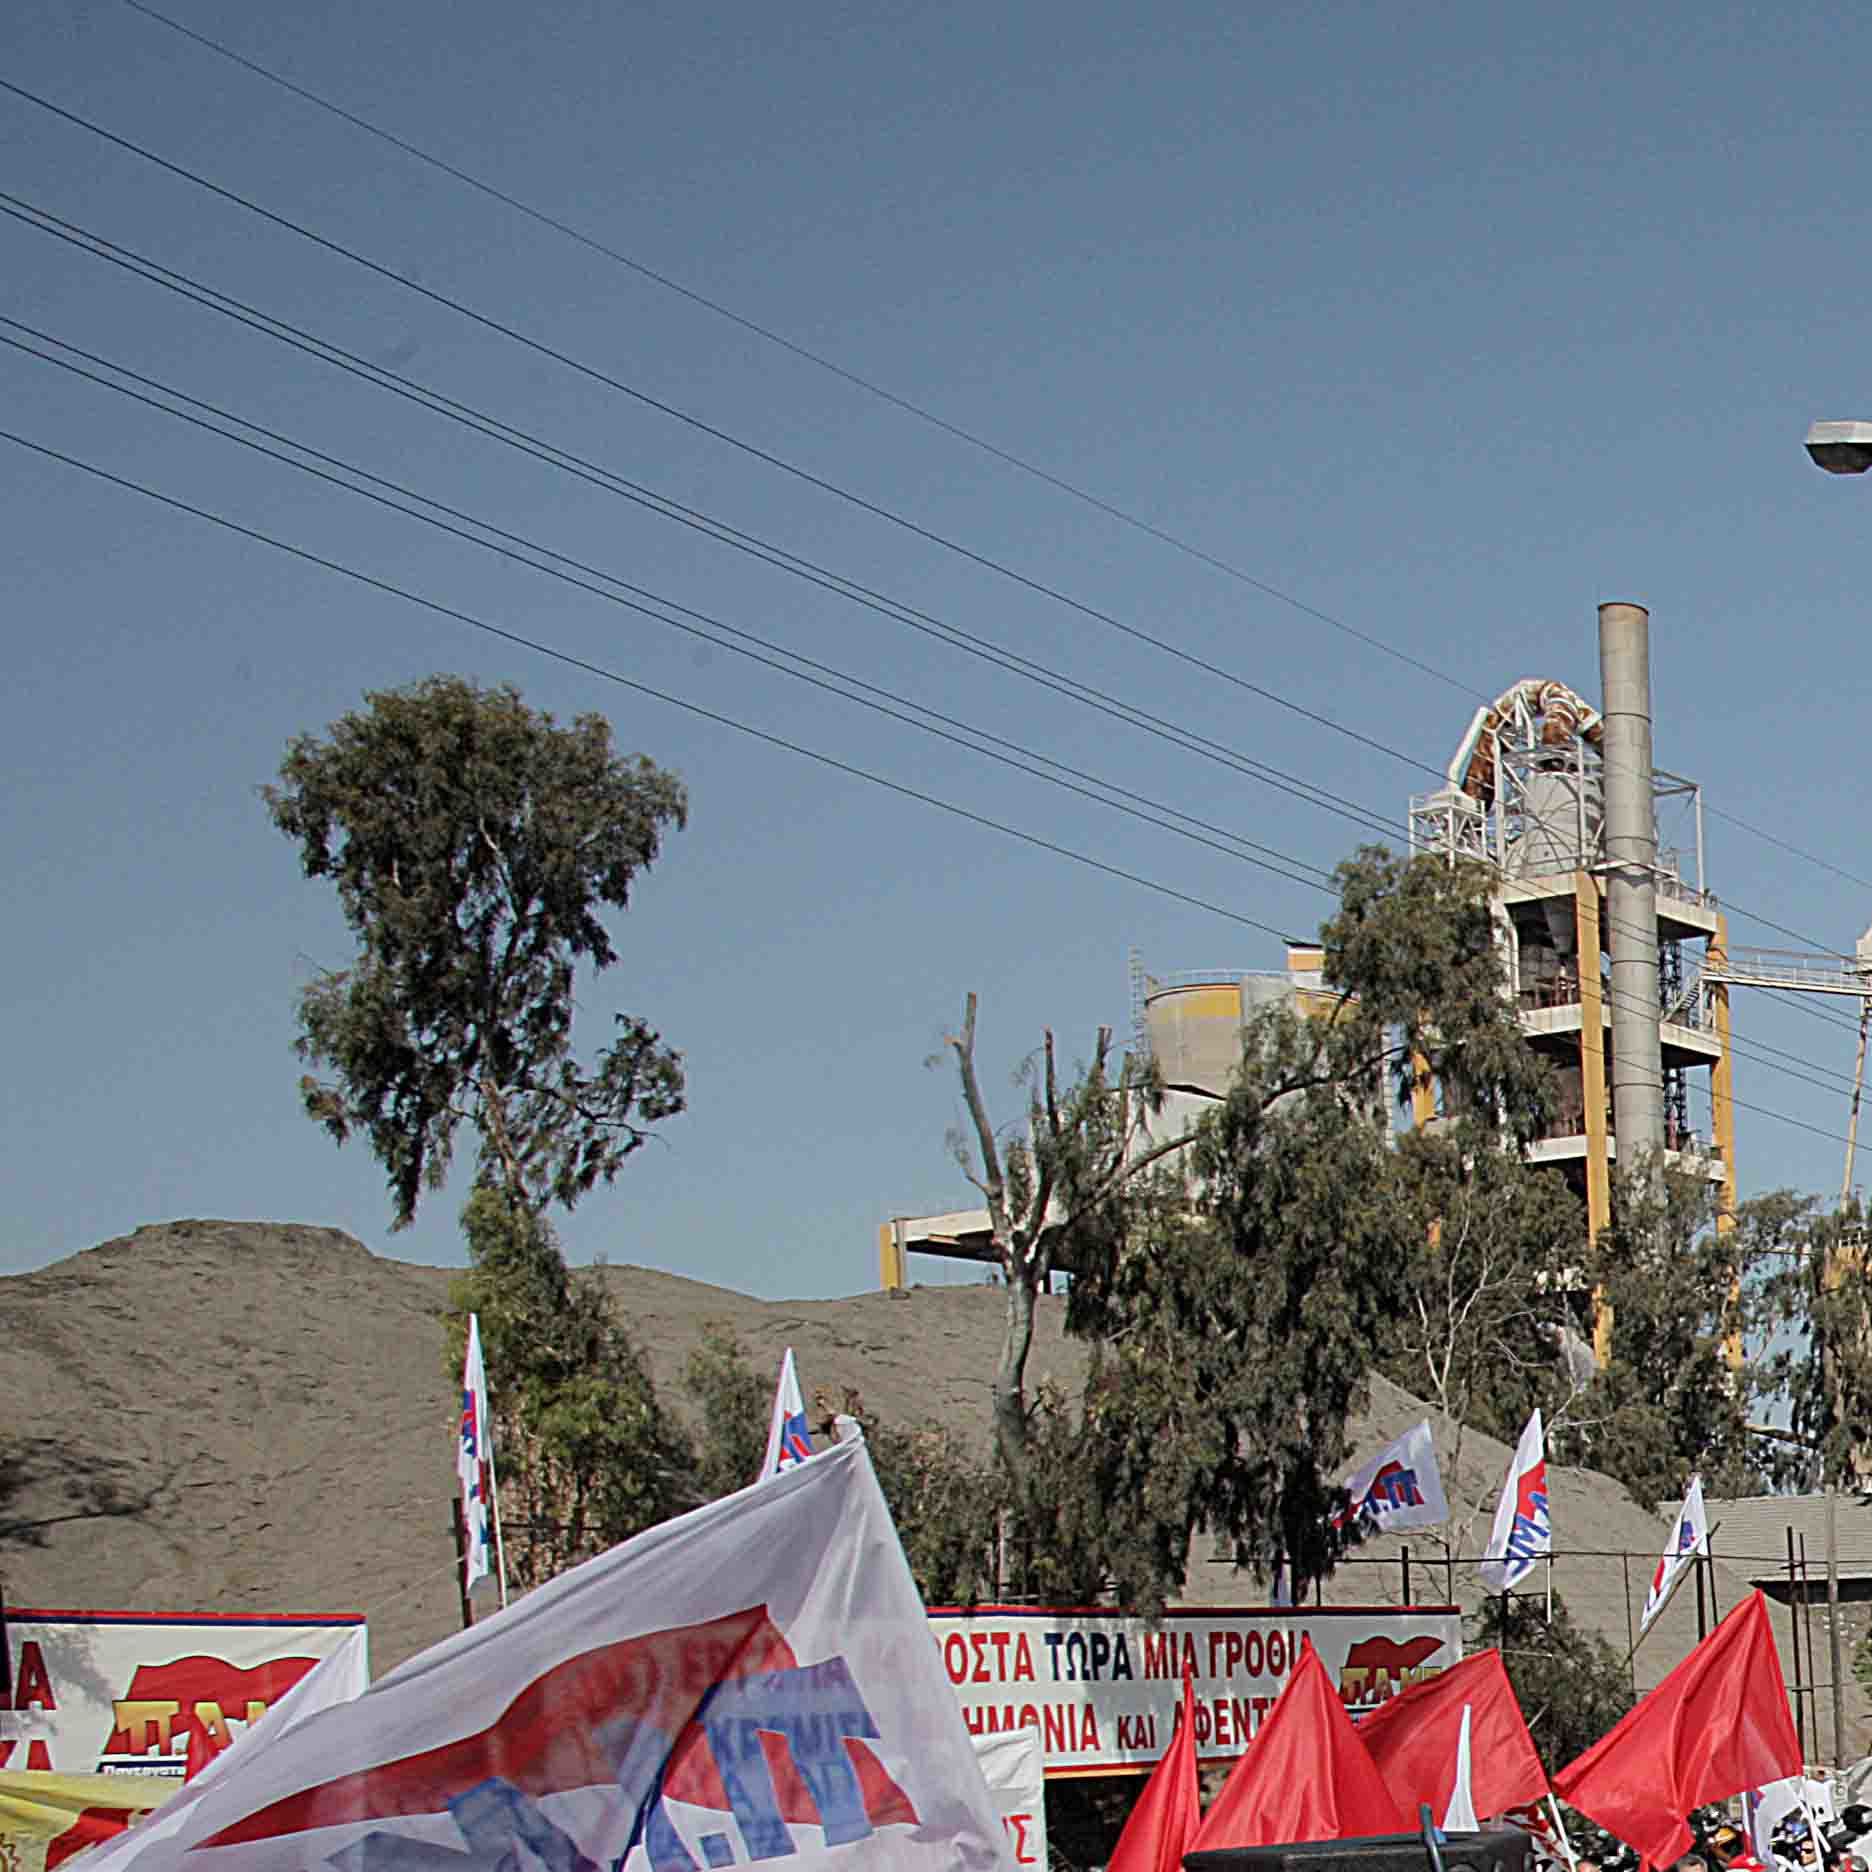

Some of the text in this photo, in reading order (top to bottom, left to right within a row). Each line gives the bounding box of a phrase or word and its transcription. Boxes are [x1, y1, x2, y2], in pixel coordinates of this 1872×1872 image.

[936, 1631, 1035, 1685] ΟΣΤΑ
[1044, 1631, 1134, 1682] ΤΩΡΑ
[1143, 1631, 1200, 1681] ΜΙΑ
[1117, 1714, 1157, 1749] ΚΑΙ
